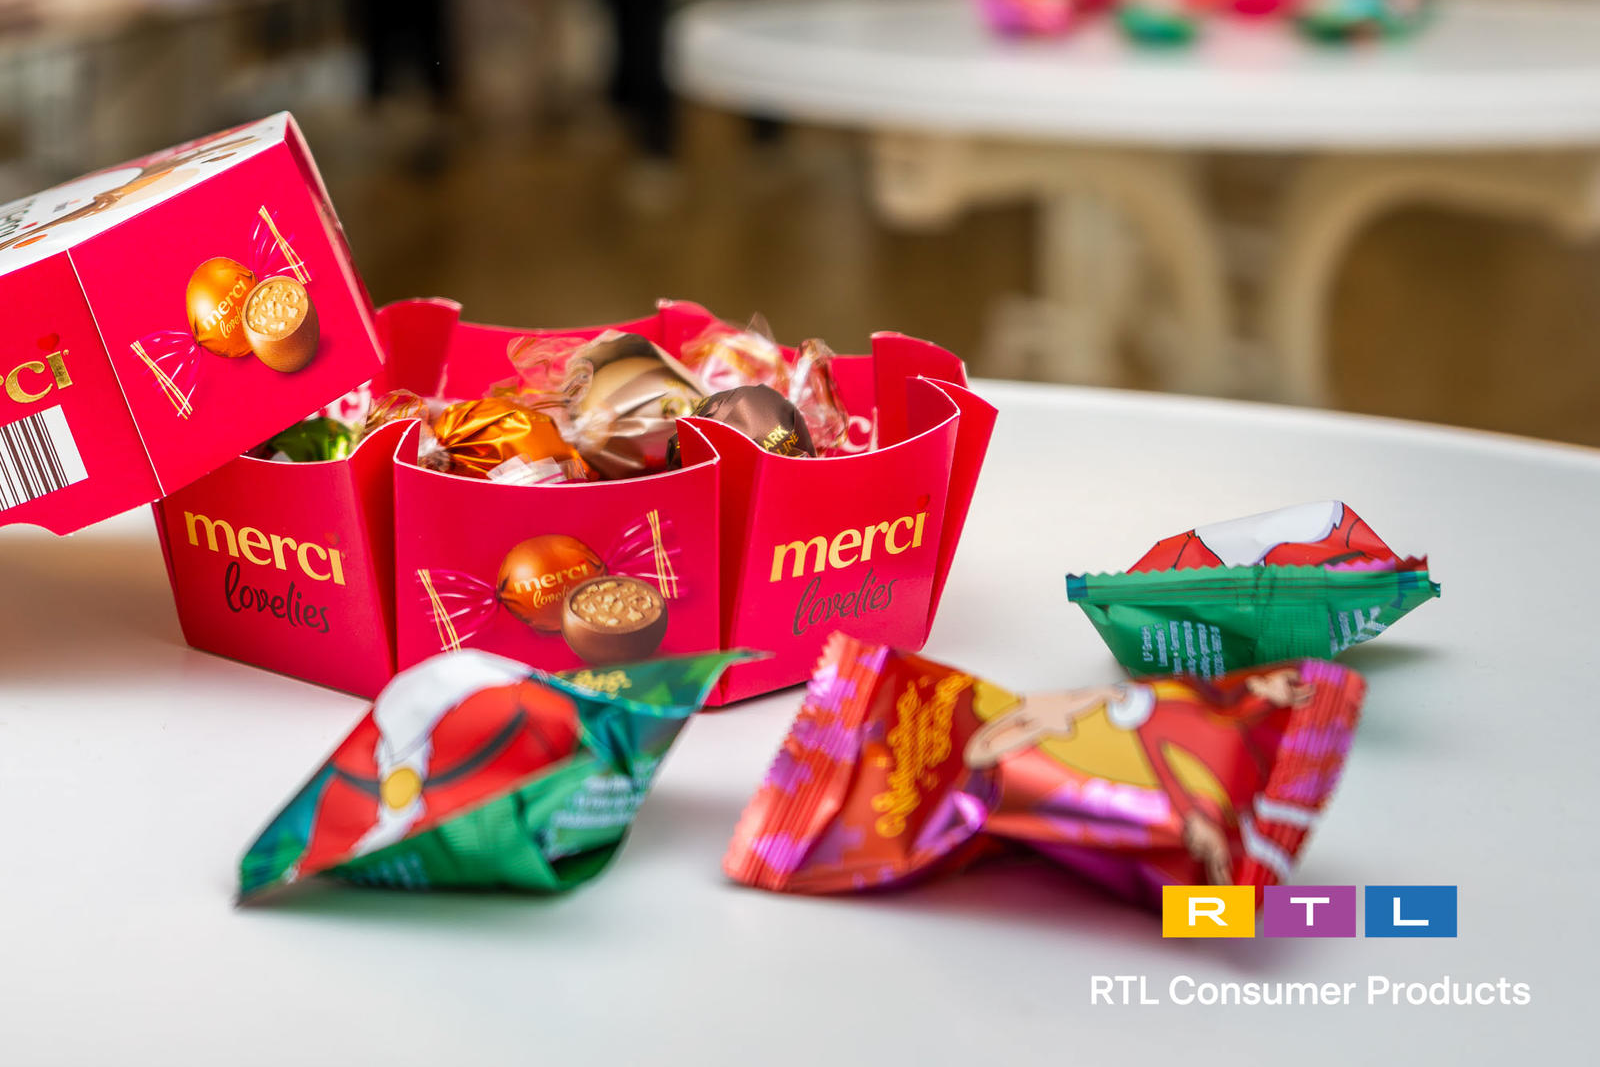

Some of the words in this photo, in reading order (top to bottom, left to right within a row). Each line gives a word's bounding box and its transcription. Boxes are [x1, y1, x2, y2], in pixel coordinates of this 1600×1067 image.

[203, 276, 247, 331] merci
[763, 425, 790, 451] ARK
[184, 511, 346, 586] merci
[769, 495, 929, 583] merci
[225, 561, 330, 634] lovelies
[514, 560, 589, 594] merci
[793, 567, 898, 636] lovelies
